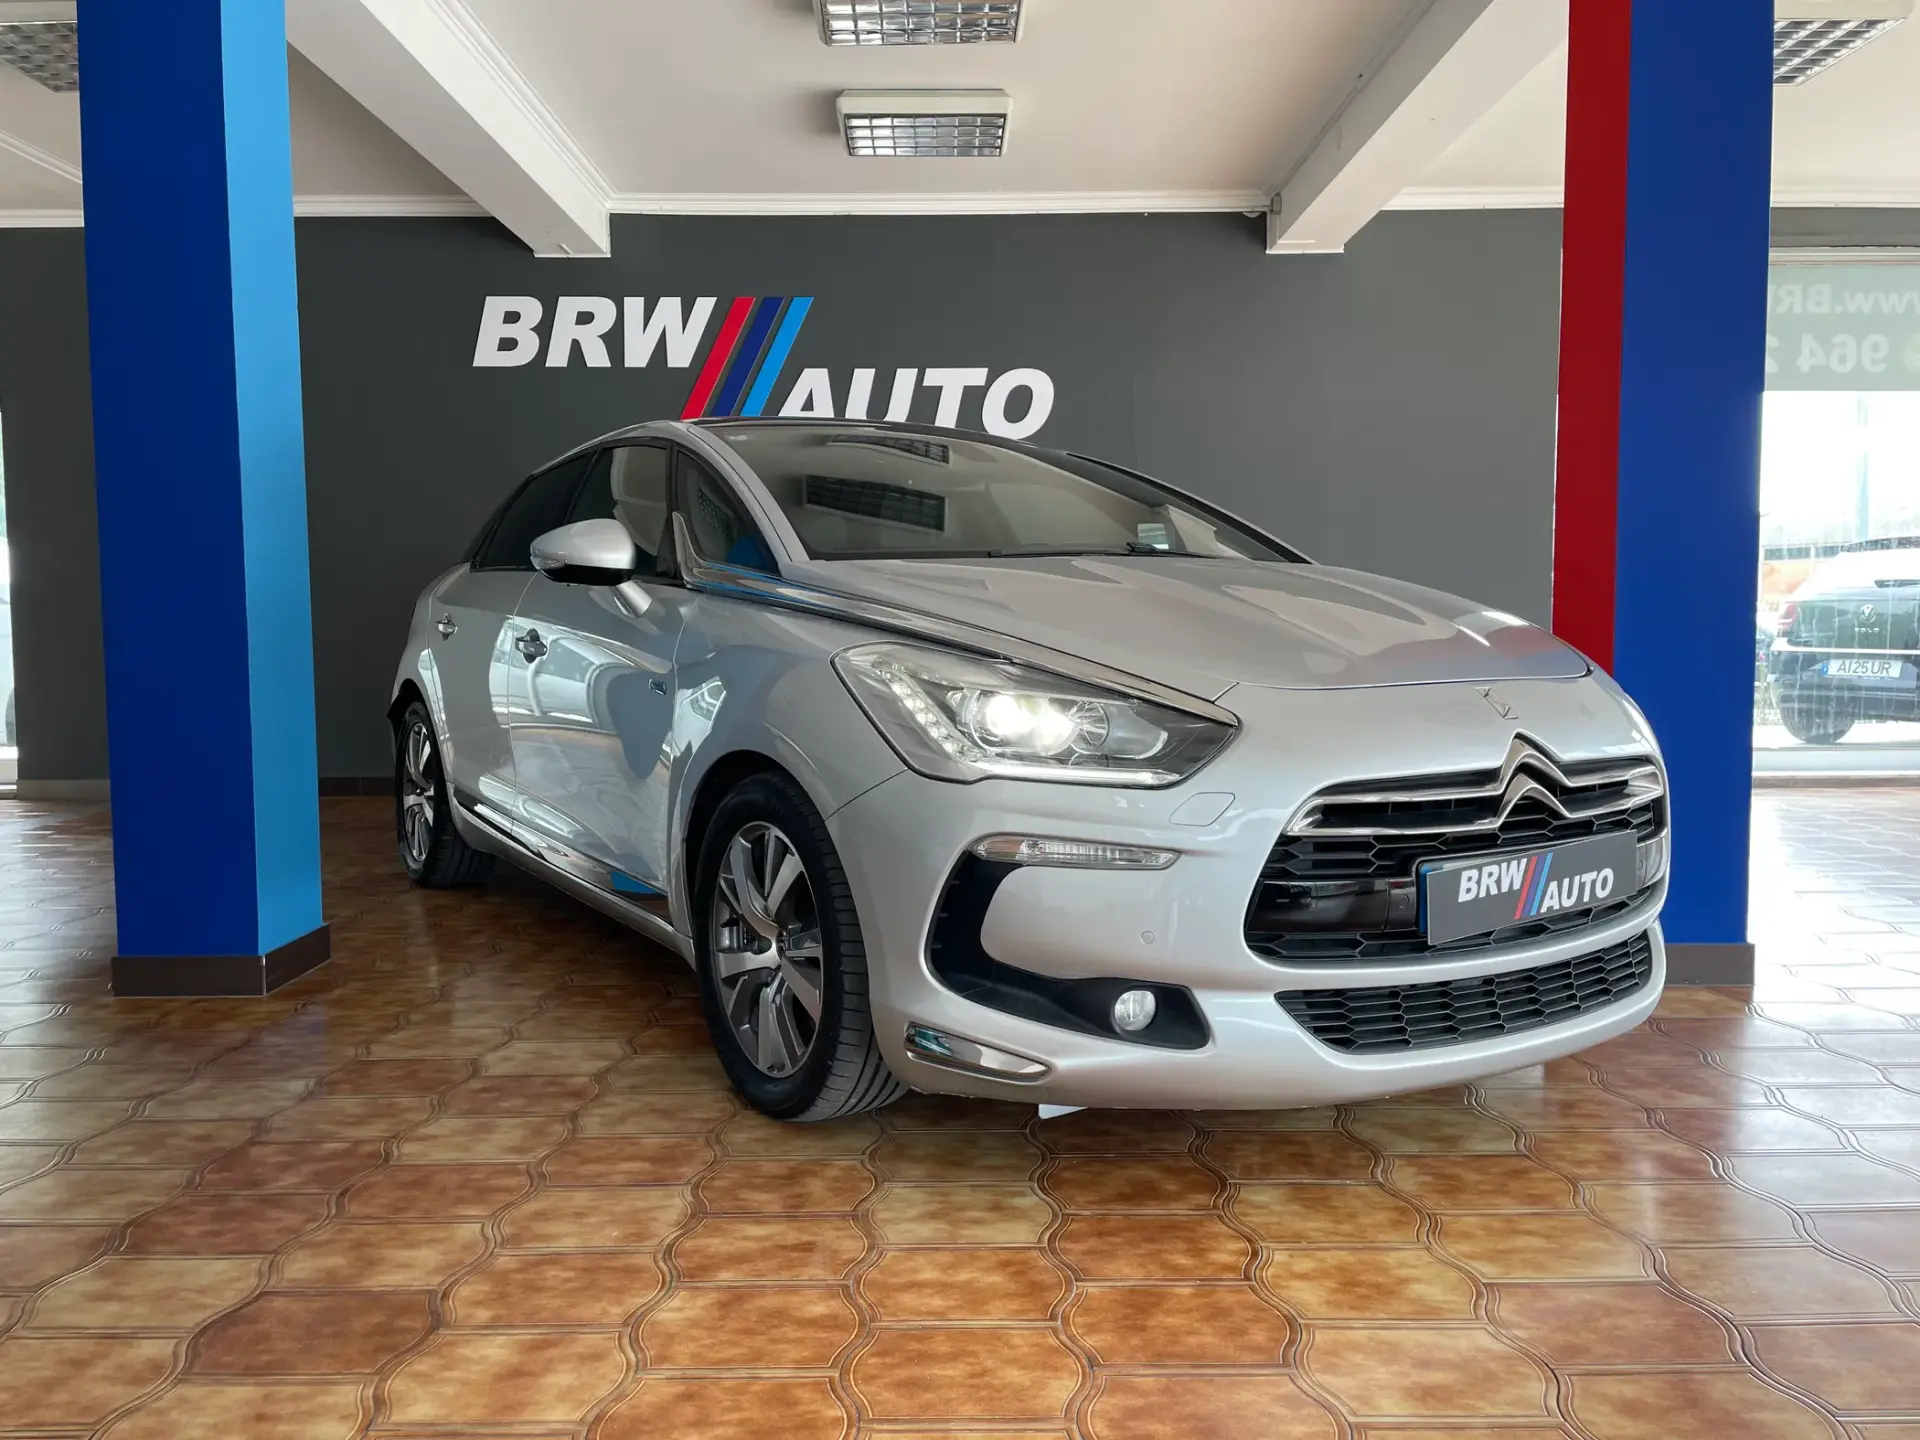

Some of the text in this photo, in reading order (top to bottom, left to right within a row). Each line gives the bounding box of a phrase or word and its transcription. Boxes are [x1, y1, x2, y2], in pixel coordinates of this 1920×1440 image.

[473, 296, 717, 368] BRW
[778, 367, 1054, 440] AUTO
[1458, 858, 1527, 903] BRW
[1540, 868, 1614, 913] AUTO
